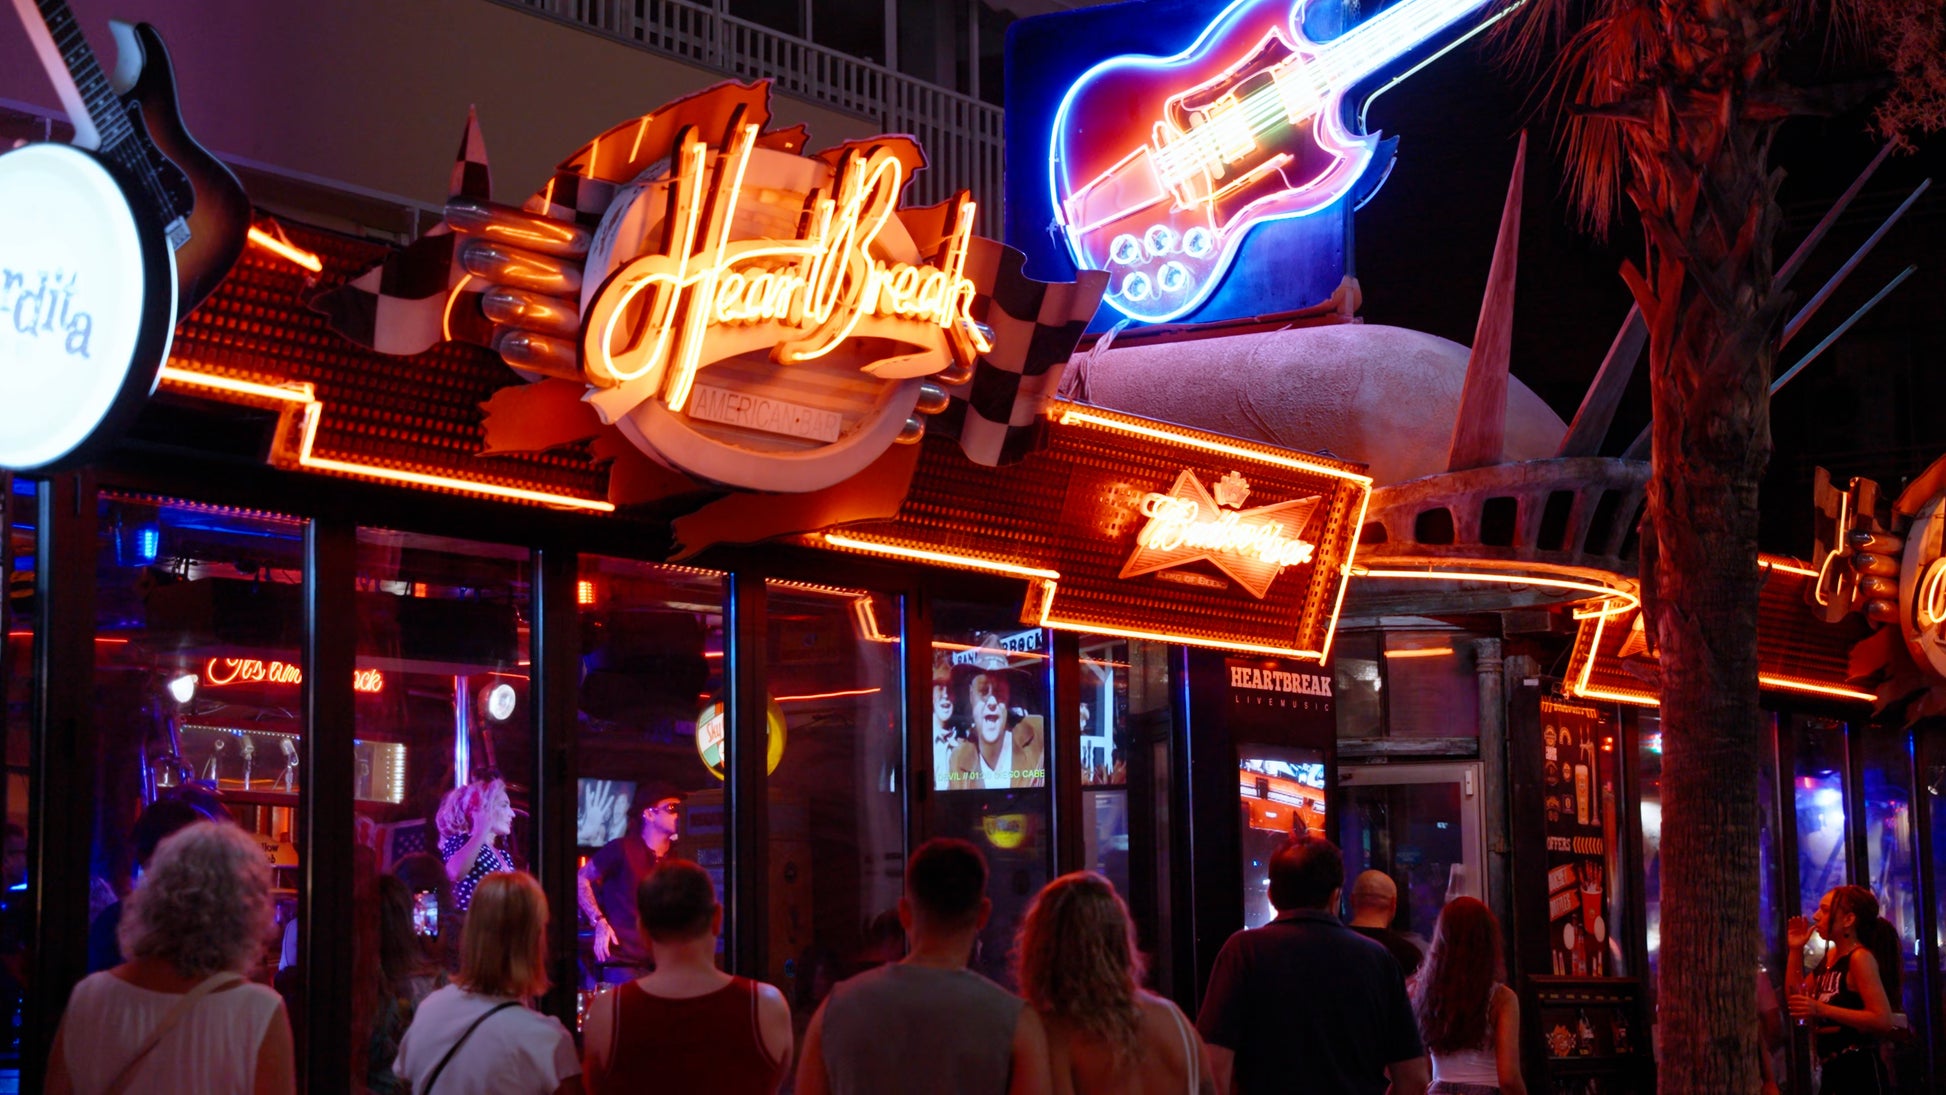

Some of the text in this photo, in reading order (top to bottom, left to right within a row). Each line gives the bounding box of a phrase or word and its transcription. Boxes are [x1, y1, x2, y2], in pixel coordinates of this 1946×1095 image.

[0, 267, 92, 358] rdita
[694, 387, 839, 438] AMERICAN BAR
[1230, 666, 1333, 698] HEARTBREAK
